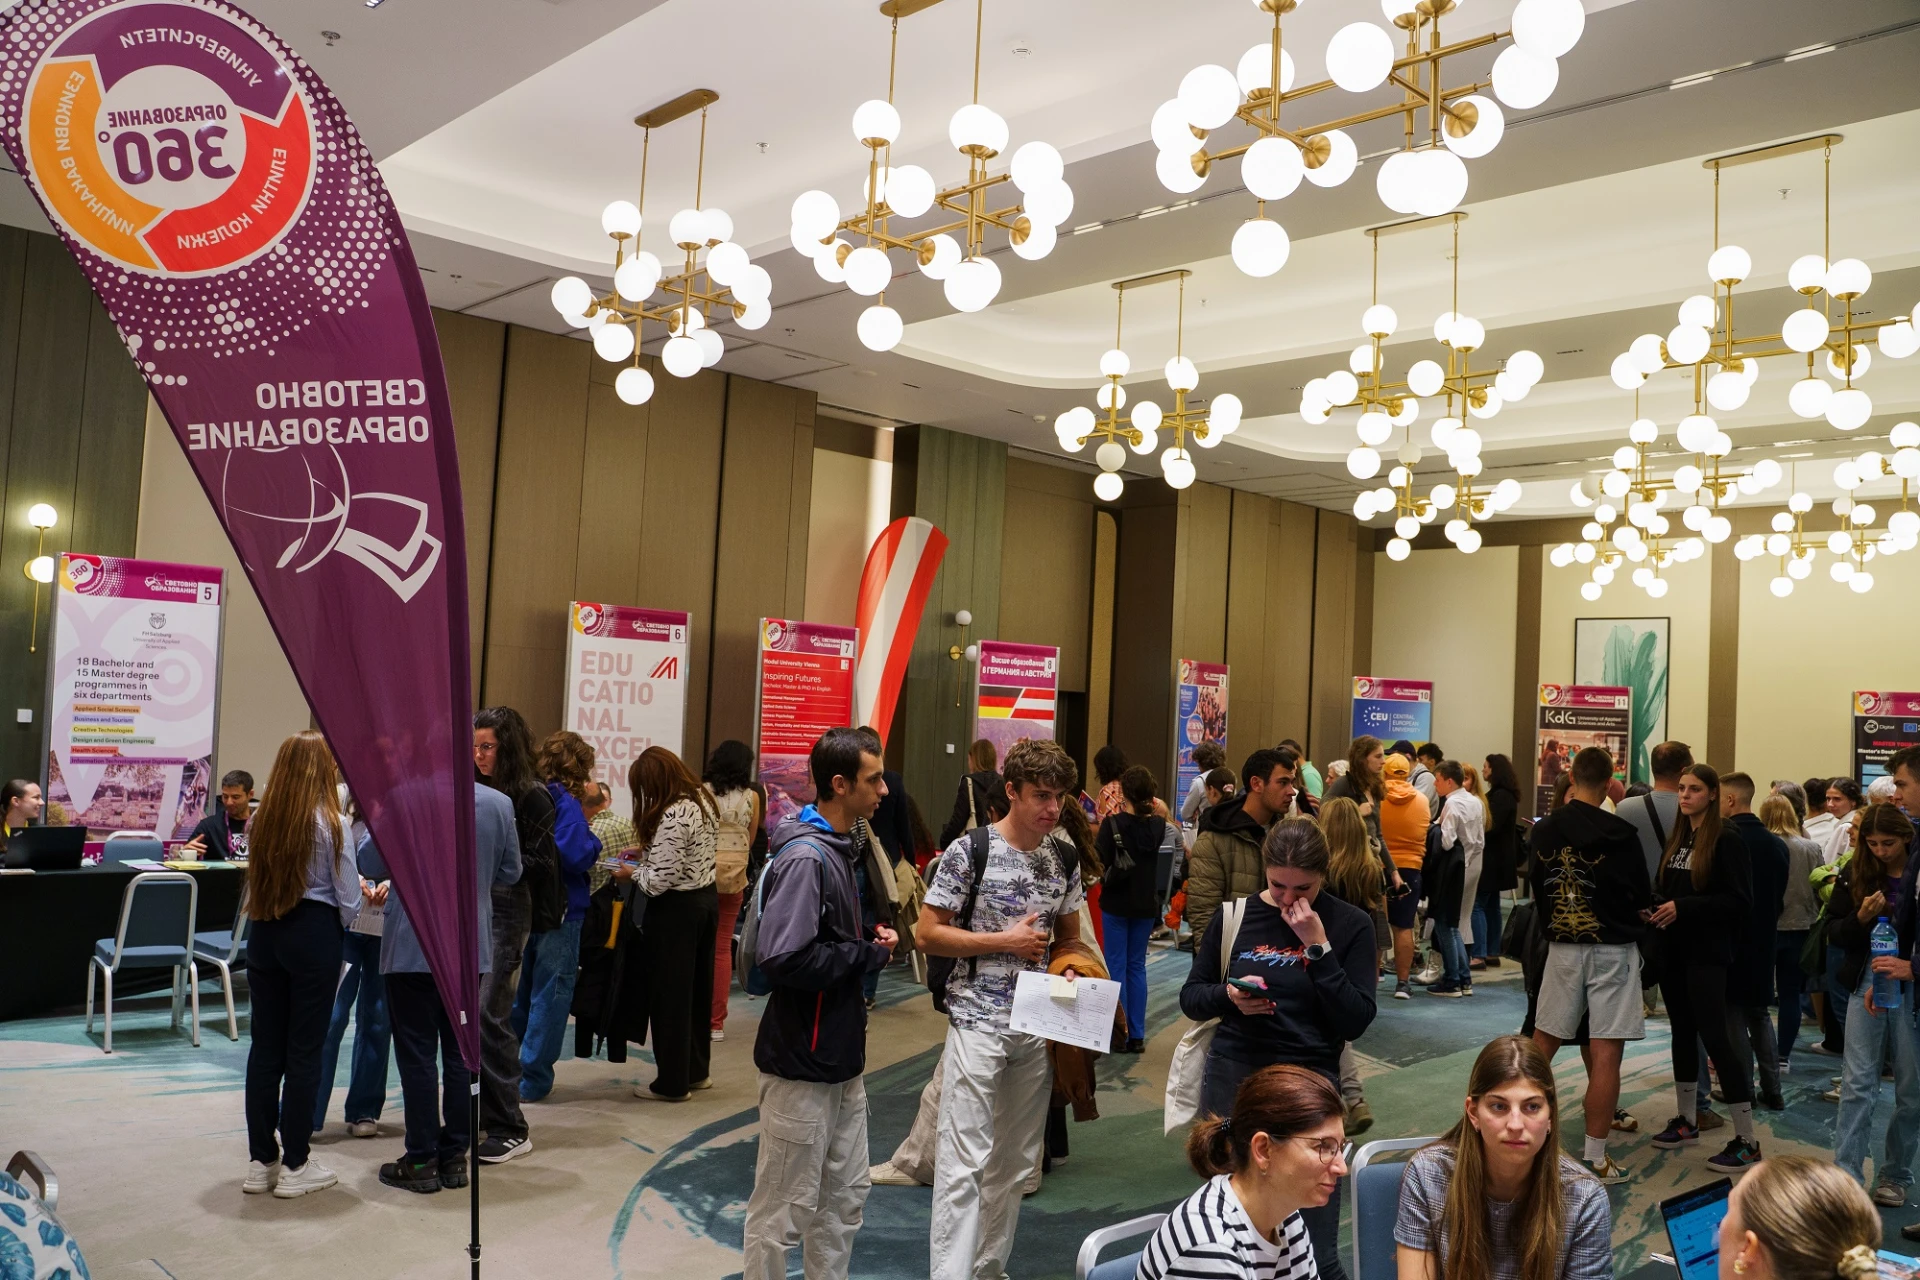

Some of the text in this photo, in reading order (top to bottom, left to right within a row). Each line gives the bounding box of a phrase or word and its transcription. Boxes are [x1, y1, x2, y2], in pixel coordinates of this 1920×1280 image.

[165, 579, 197, 588] СВЕТОВНО
[151, 585, 197, 594] ОБРАЗОВАНИЕ
[204, 587, 212, 600] 5
[675, 628, 681, 640] 6
[845, 643, 850, 653] 7
[77, 657, 154, 669] 18 Bachelor and
[580, 650, 633, 676] EDU
[779, 659, 802, 667] University
[1047, 660, 1052, 670] 8
[77, 668, 160, 680] 15 Master degree
[763, 672, 821, 683] Inspiring Futures
[987, 666, 1020, 676] ГЕРМАНИЯ
[1025, 669, 1052, 679] АВСТРИЯ
[74, 681, 148, 690] programmes in
[74, 691, 152, 701] six departments
[578, 678, 653, 705] CATIO
[1420, 691, 1428, 699] 10
[1617, 698, 1626, 706] 11
[74, 705, 96, 713] Applied
[577, 707, 631, 732] NAL
[1370, 712, 1388, 720] CEU
[1545, 709, 1576, 724] KdG
